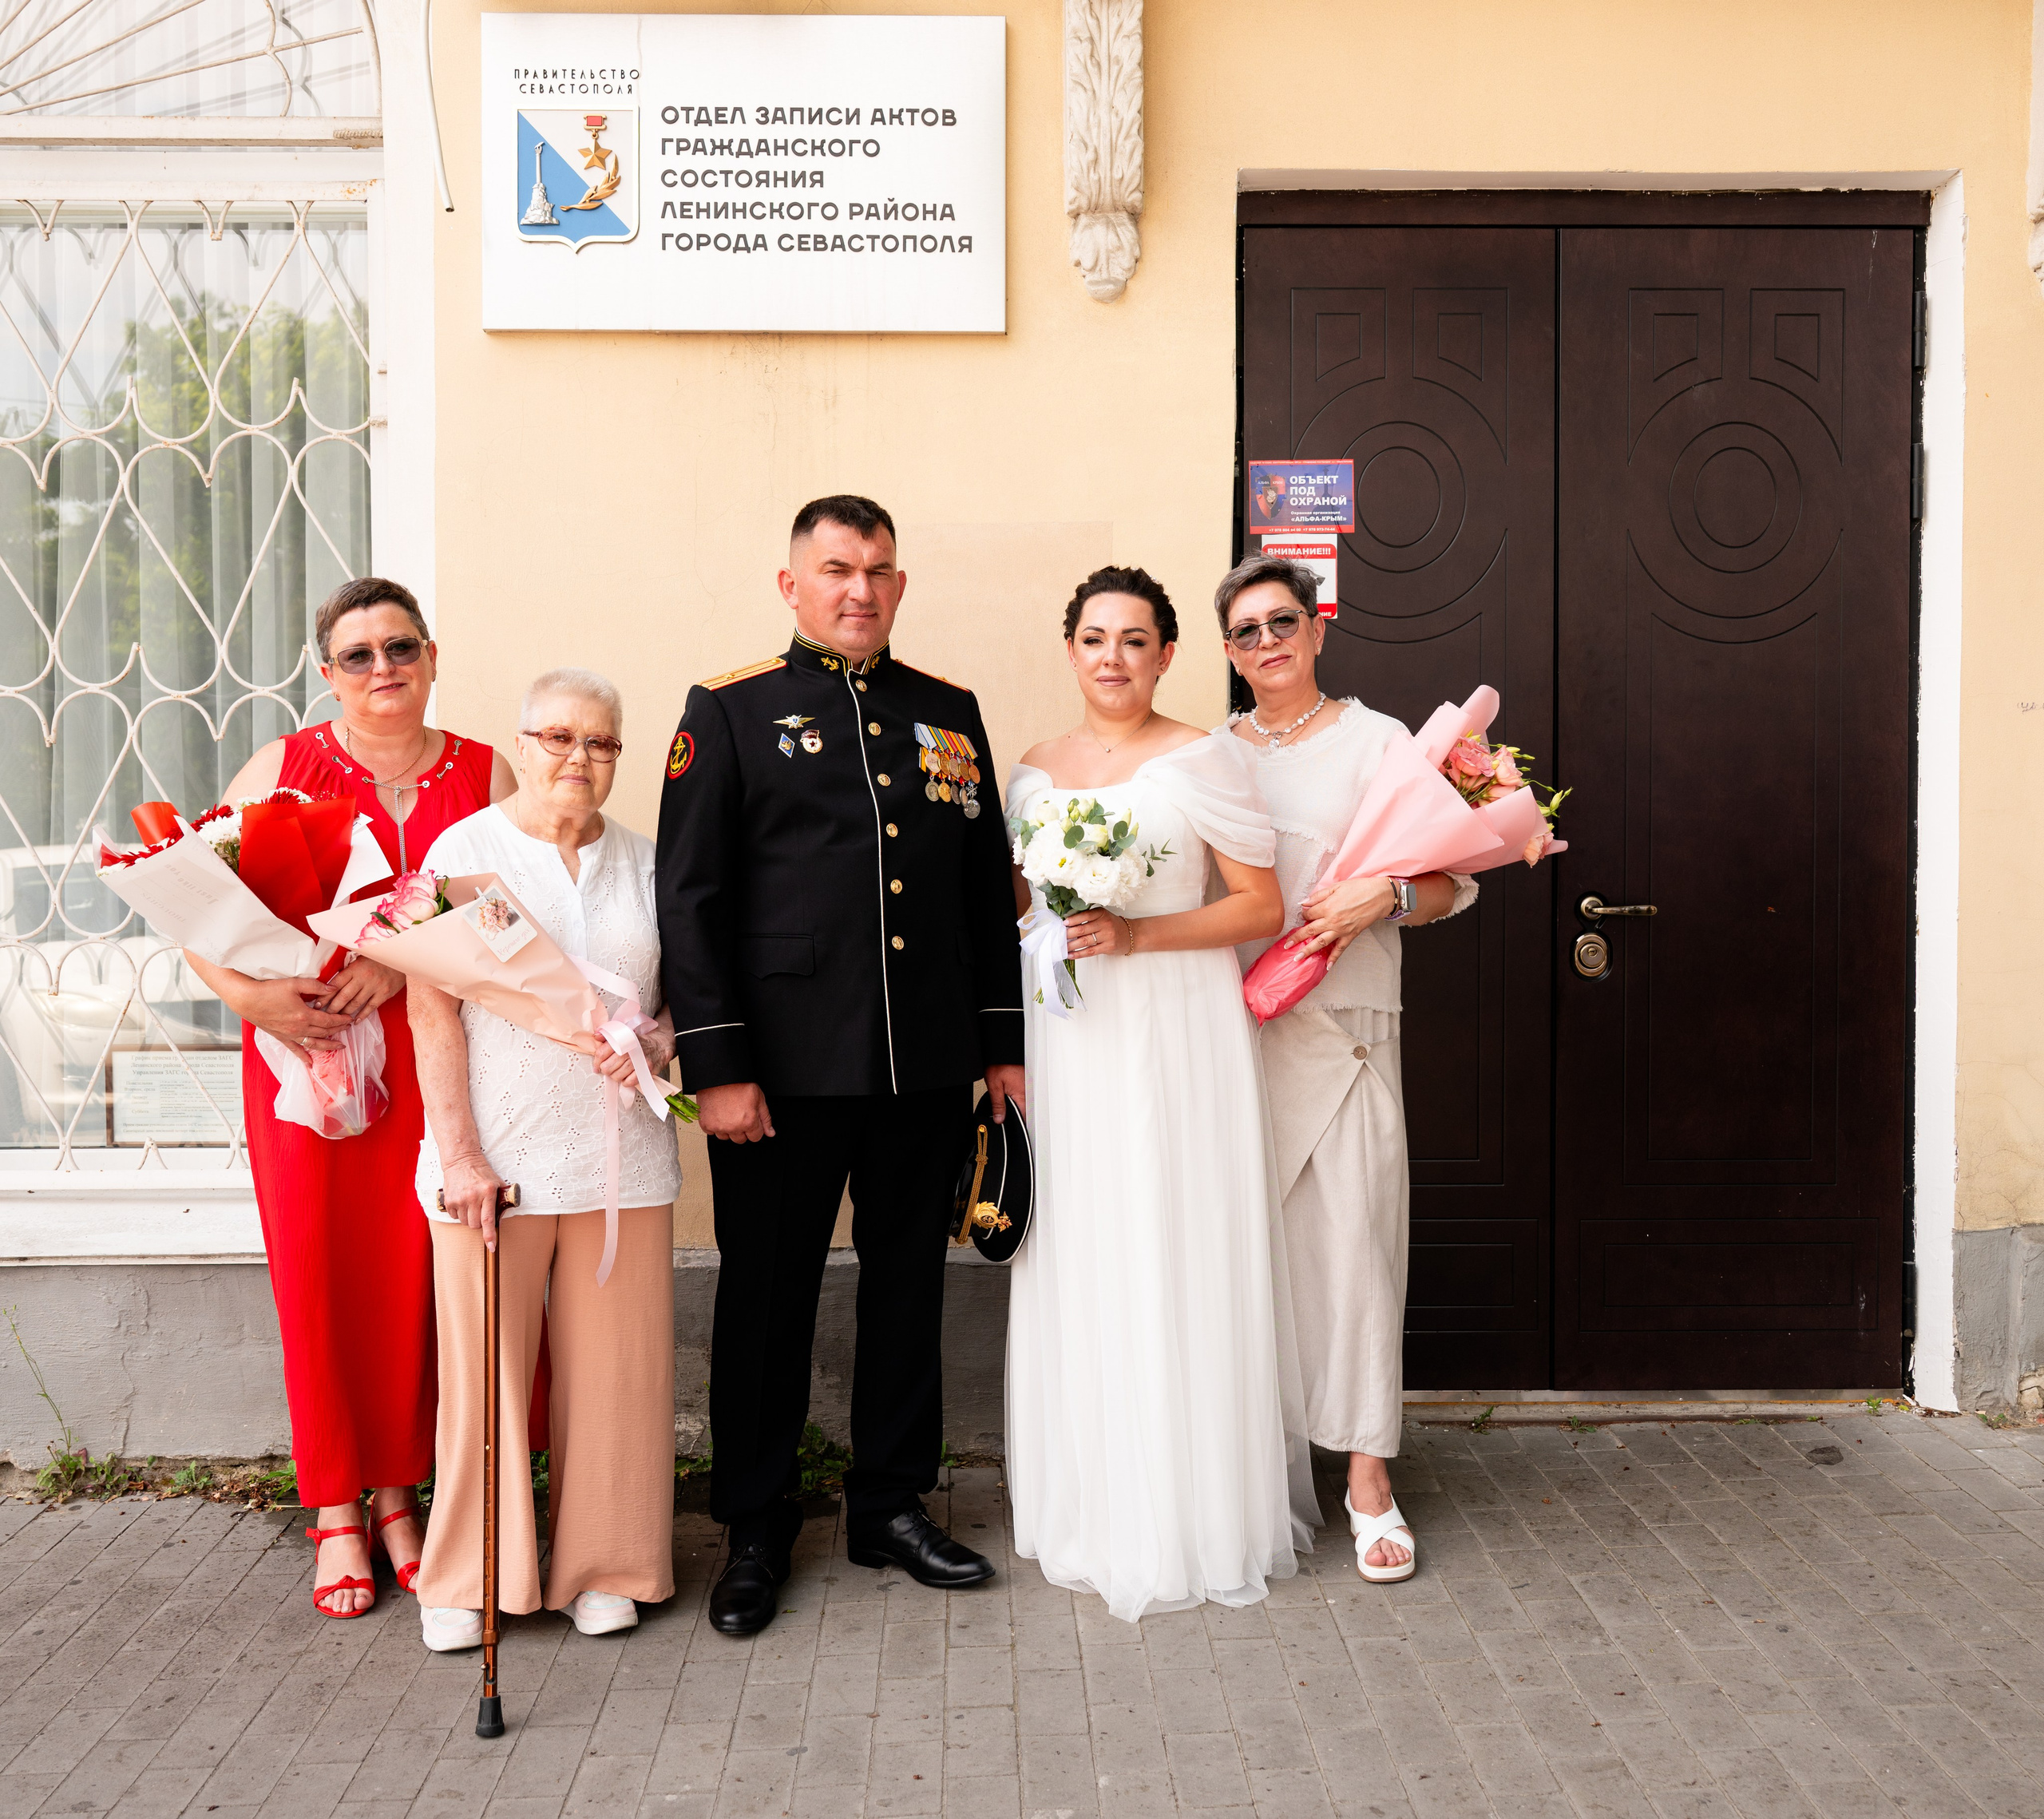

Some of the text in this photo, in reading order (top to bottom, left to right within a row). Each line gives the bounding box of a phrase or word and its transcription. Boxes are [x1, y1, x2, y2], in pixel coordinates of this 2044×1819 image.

[513, 69, 640, 80] ПРАВИТЕЛЬСТВО
[519, 84, 633, 94] СЕВАСТОПОЛЯ
[661, 105, 957, 127] ОТДЕЛ ЗАПИСИ АКТОВ
[661, 137, 881, 159] ГРАЖДАНСКОГО
[660, 168, 824, 188] СОСТОЯНИЯ
[660, 197, 956, 221] ЛЕНИНСКОГО РАЙОНА
[661, 232, 972, 254] ГОРОДА СЕВАСТОПОЛЯ
[1289, 476, 1339, 485] ОБЪЕКТ
[1289, 486, 1316, 496] ПОД
[1289, 495, 1347, 506] ОХРАНОЙ
